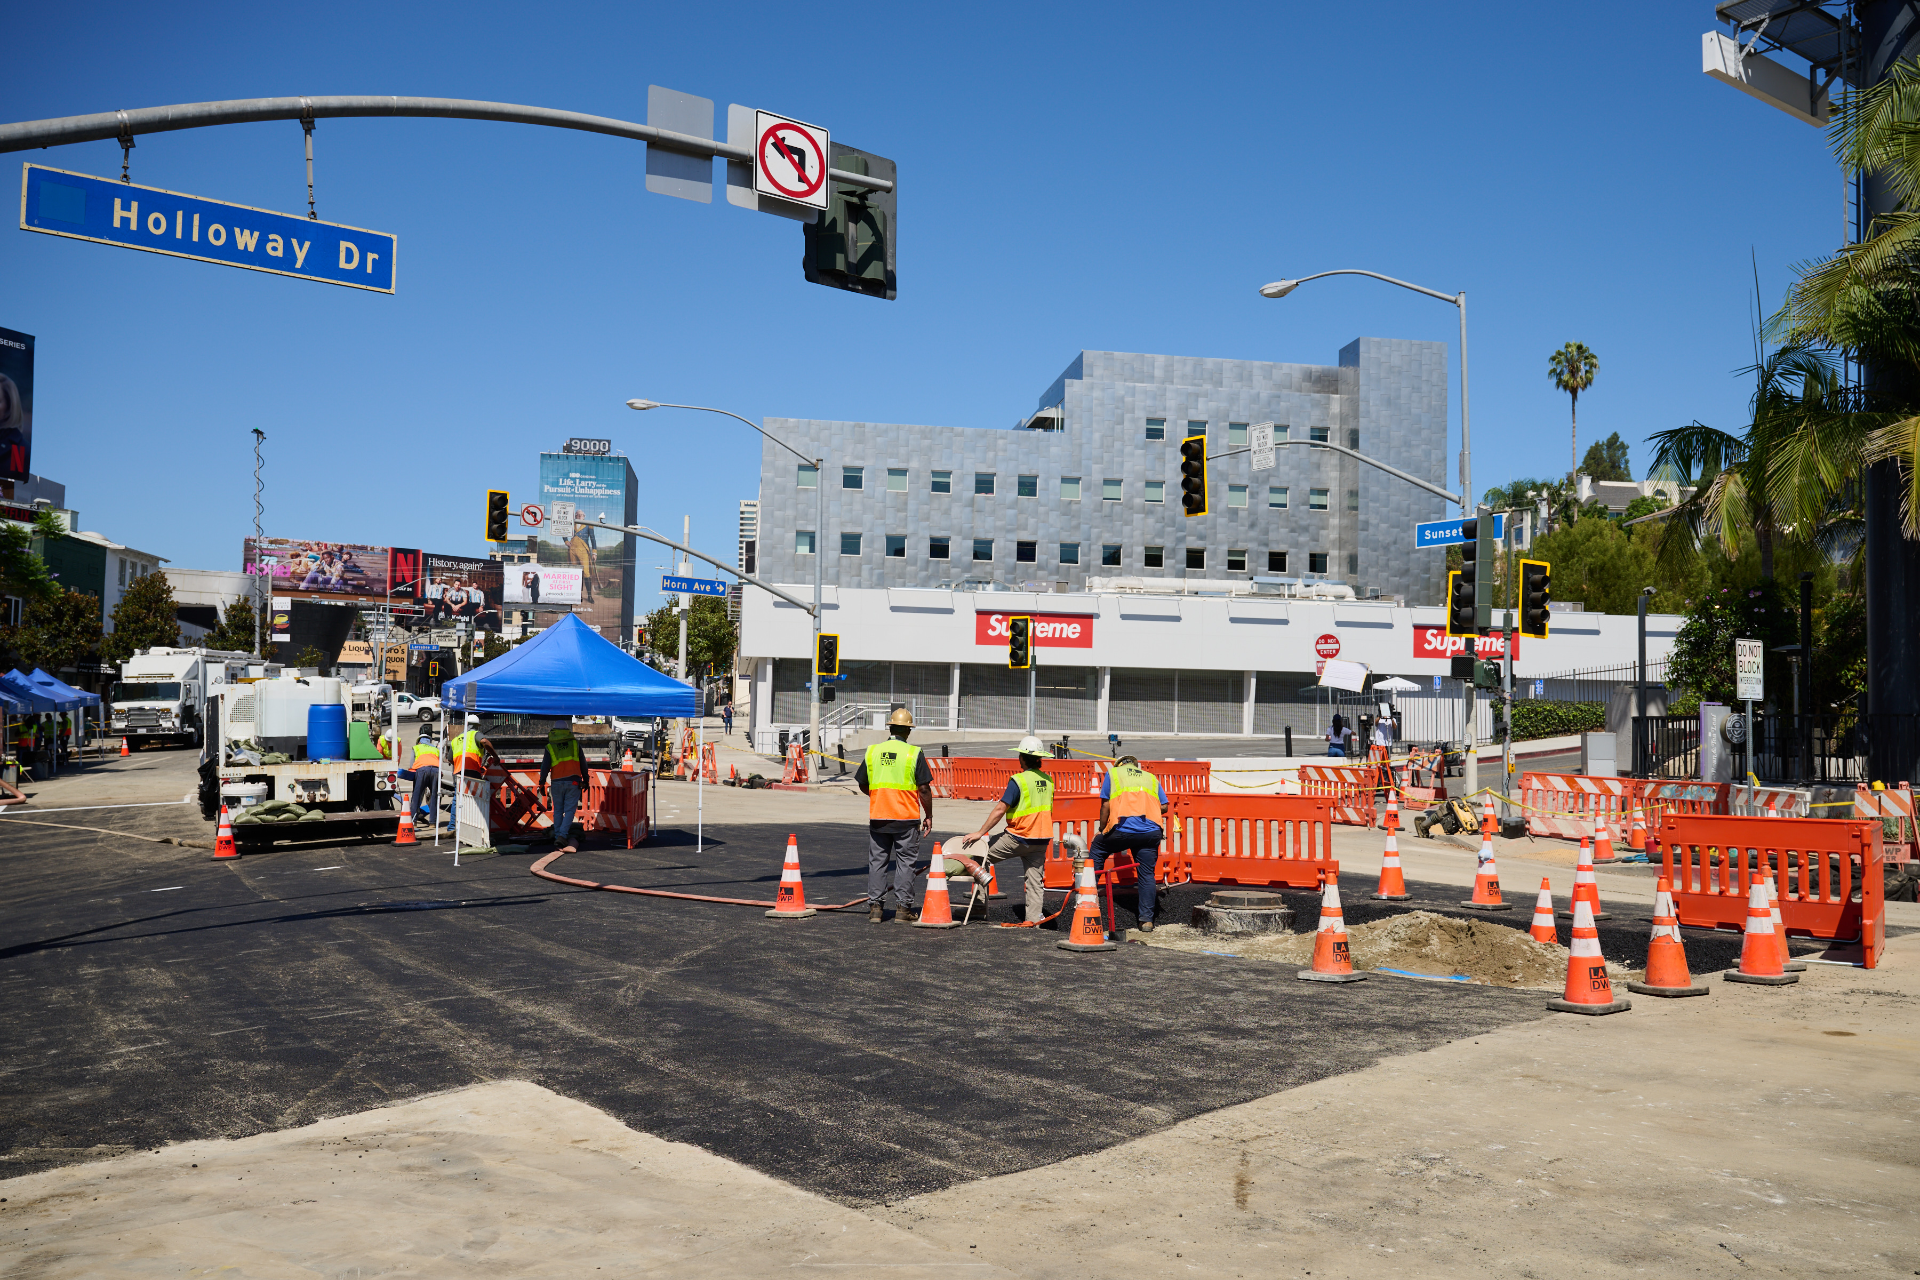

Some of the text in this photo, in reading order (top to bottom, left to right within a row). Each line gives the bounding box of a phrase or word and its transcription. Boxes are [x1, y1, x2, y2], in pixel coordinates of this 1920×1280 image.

[113, 197, 379, 274] Holloway Dr
[571, 439, 609, 452] 9000
[10, 444, 26, 473] N
[559, 478, 576, 487] Life,
[576, 479, 597, 489] Larry
[544, 485, 571, 493] Pursuit
[575, 486, 621, 496] Unhappiness
[1424, 526, 1463, 540] Sunset
[261, 555, 278, 565] 72
[428, 557, 484, 571] History, again?
[396, 553, 414, 583] N
[543, 573, 580, 581] MARRIED
[663, 578, 711, 592] Horn Ave
[987, 614, 1081, 639] Sureme
[1738, 643, 1761, 658] DO NOT
[380, 654, 405, 663] LQUOR
[1738, 660, 1762, 674] BLOCK
[1884, 847, 1902, 855] WP
[1085, 917, 1097, 925] LA
[1334, 943, 1347, 952] LA
[1335, 953, 1350, 962] DW
[1590, 967, 1605, 978] LA
[1592, 979, 1609, 990] DW
